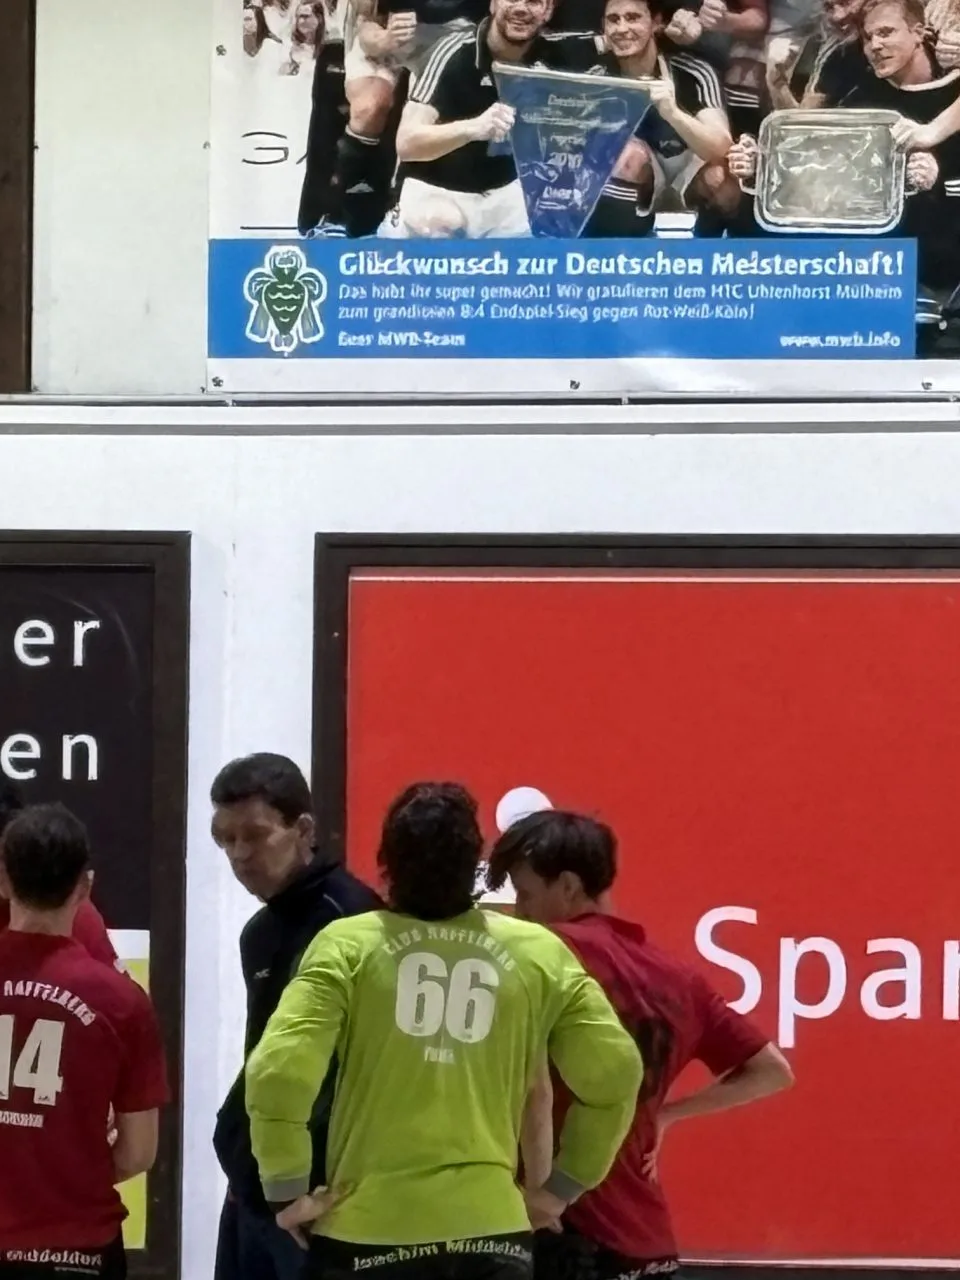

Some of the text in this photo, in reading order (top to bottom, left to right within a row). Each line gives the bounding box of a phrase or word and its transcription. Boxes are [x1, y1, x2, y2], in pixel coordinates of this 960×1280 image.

[339, 250, 904, 276] Glückwunsch zur Deutschen Meisterschaft!
[556, 283, 584, 299] Wir
[673, 284, 707, 299] dem
[394, 951, 500, 1044] 66
